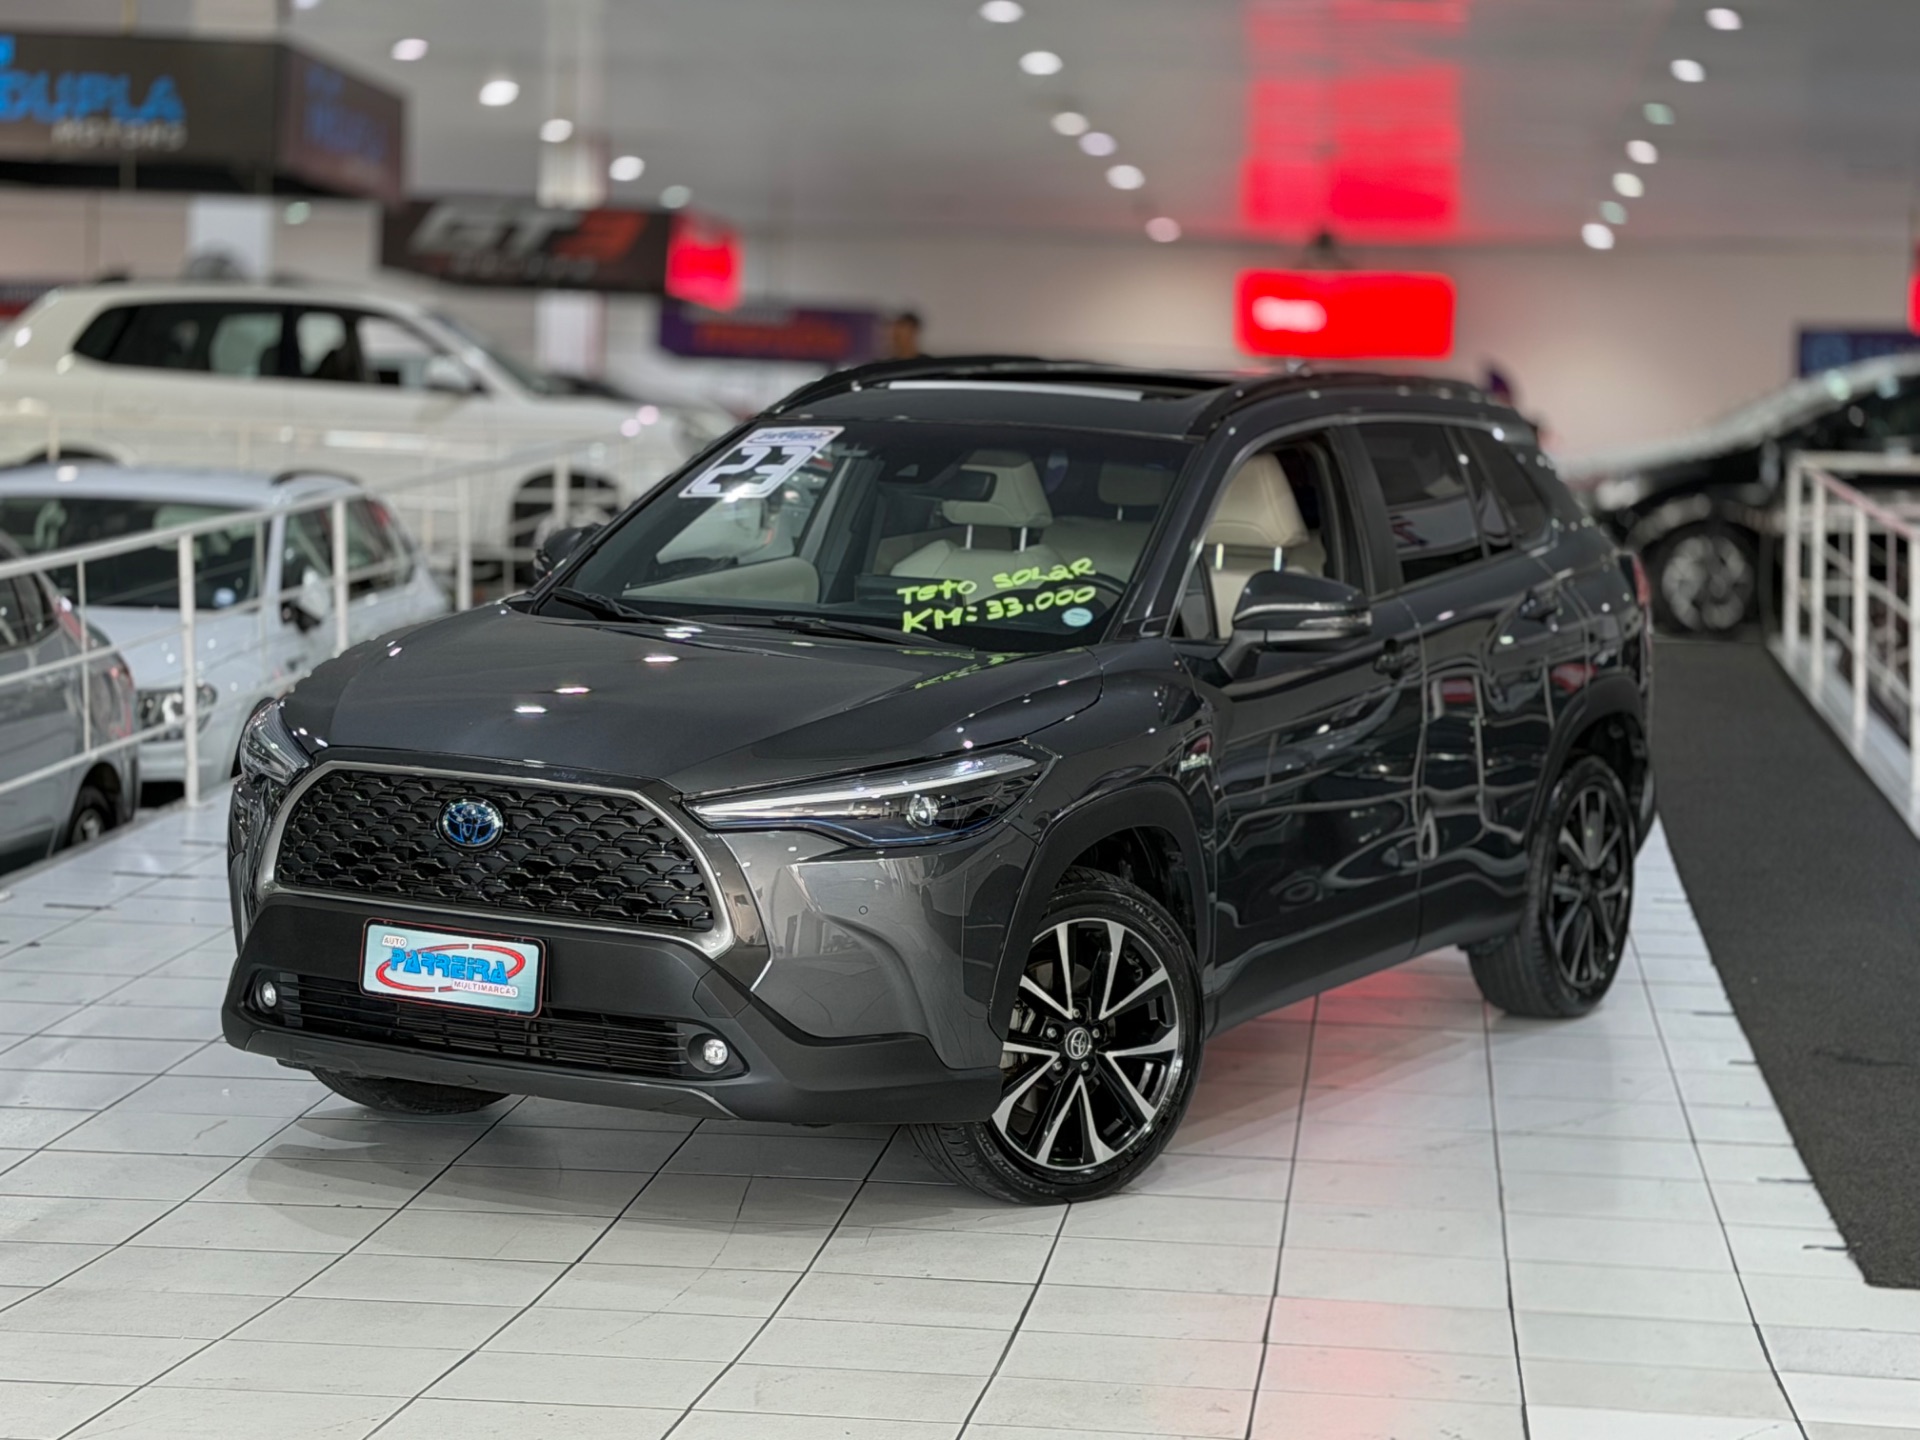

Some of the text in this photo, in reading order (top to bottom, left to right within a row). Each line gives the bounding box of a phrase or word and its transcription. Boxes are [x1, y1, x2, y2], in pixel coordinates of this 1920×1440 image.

[0, 69, 186, 127] DUPLA
[689, 445, 815, 494] 23
[902, 605, 978, 633] KM:
[985, 585, 1096, 620] 33.000
[383, 935, 406, 947] AUTO
[390, 947, 508, 985] PARREIRA
[453, 980, 517, 995] MULTIMARCAS
